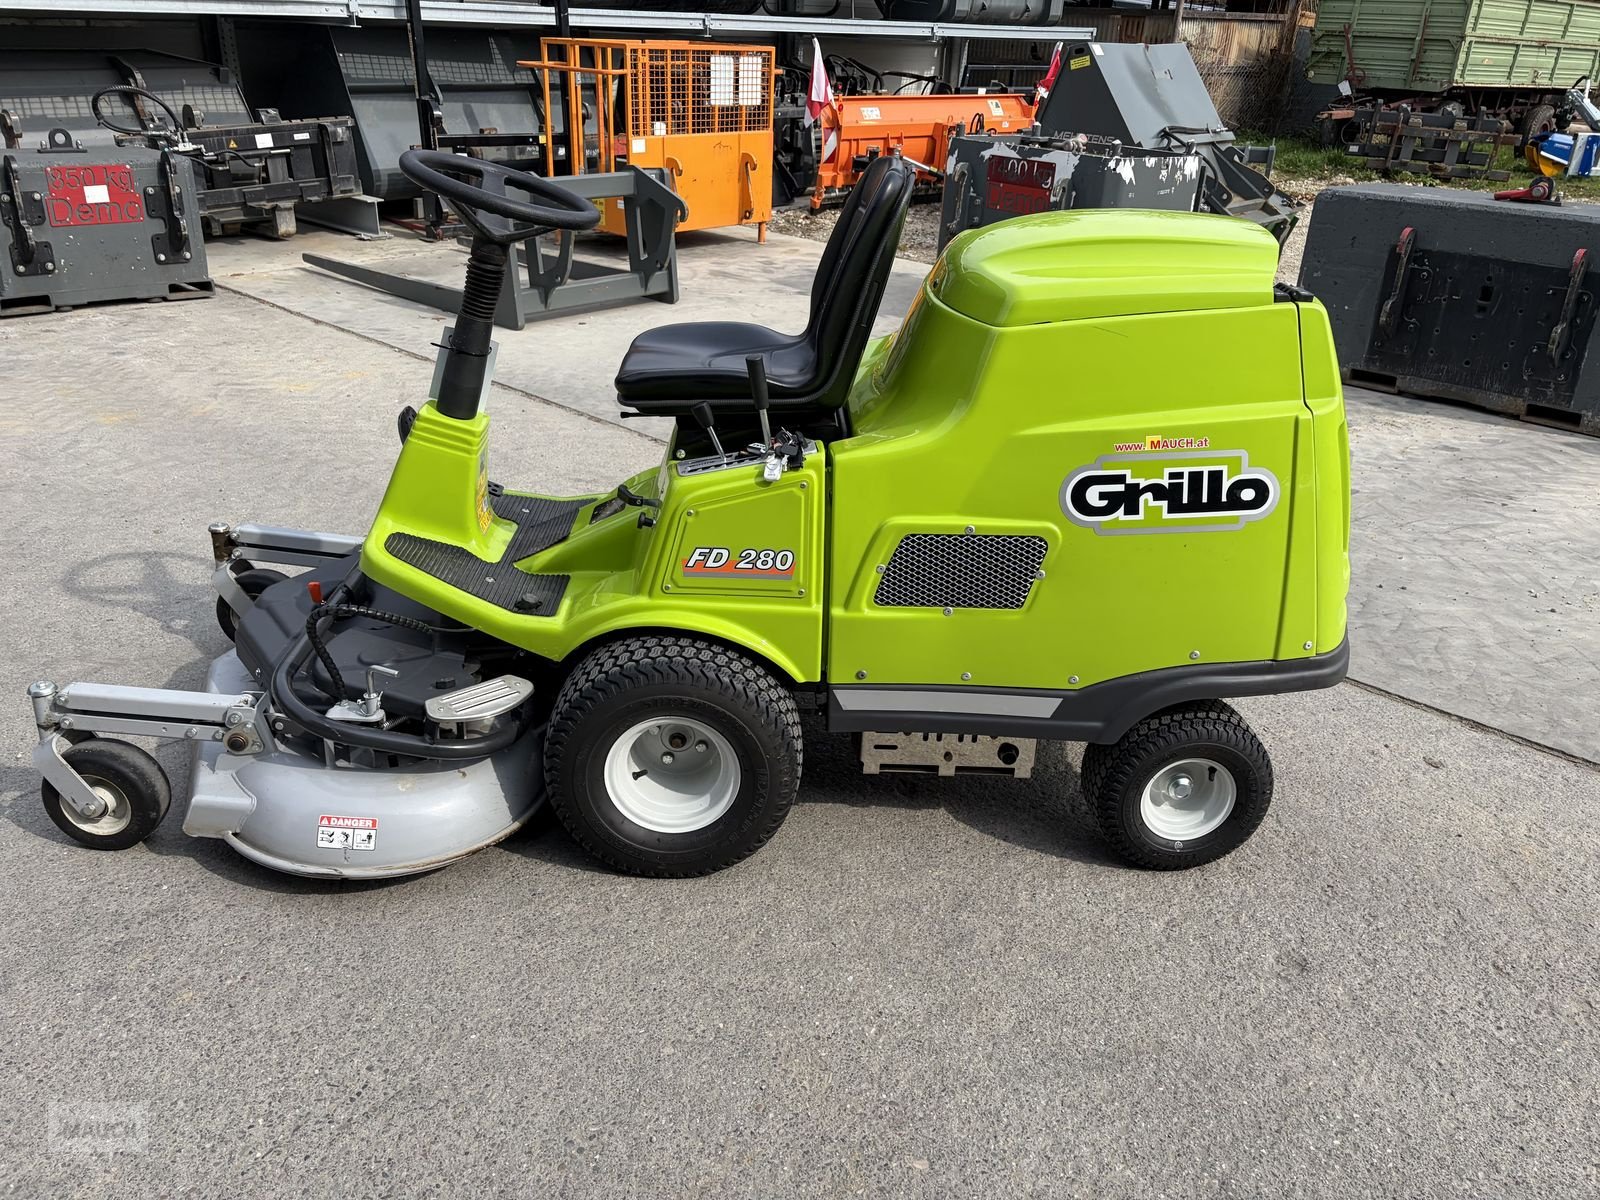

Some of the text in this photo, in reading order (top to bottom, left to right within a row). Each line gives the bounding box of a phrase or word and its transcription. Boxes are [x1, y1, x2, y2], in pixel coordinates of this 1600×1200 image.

[49, 167, 132, 192] 850 kg
[50, 199, 141, 224] Demo
[1070, 470, 1270, 517] Grillo
[685, 547, 795, 571] FD 280
[330, 818, 372, 828] DANGER
